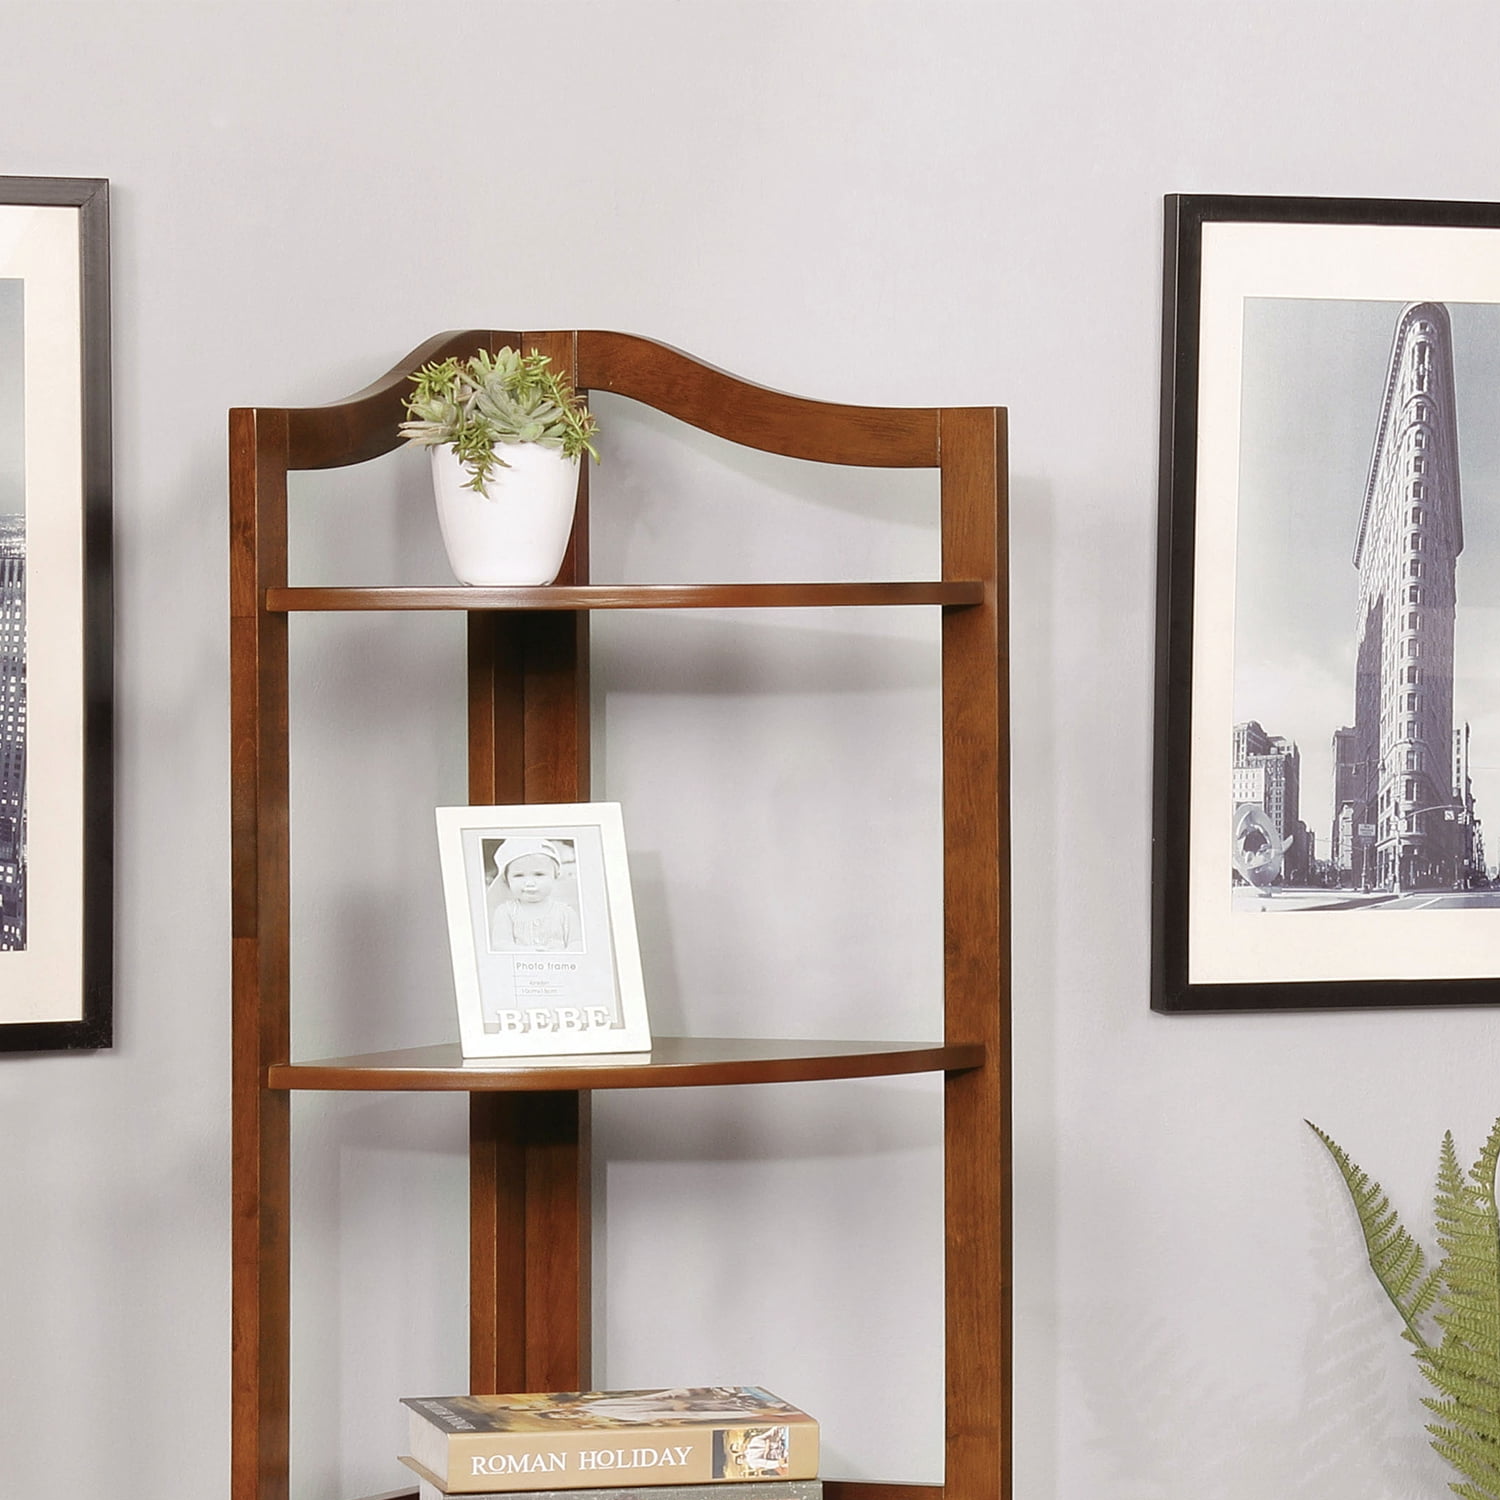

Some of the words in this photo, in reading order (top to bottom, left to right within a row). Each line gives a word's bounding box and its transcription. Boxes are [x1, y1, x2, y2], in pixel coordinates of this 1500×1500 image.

[516, 962, 544, 970] Photo
[547, 962, 577, 970] frame
[496, 1005, 610, 1034] BEBE
[471, 1452, 567, 1476] ROMAN
[578, 1446, 693, 1470] HOLIDAY
